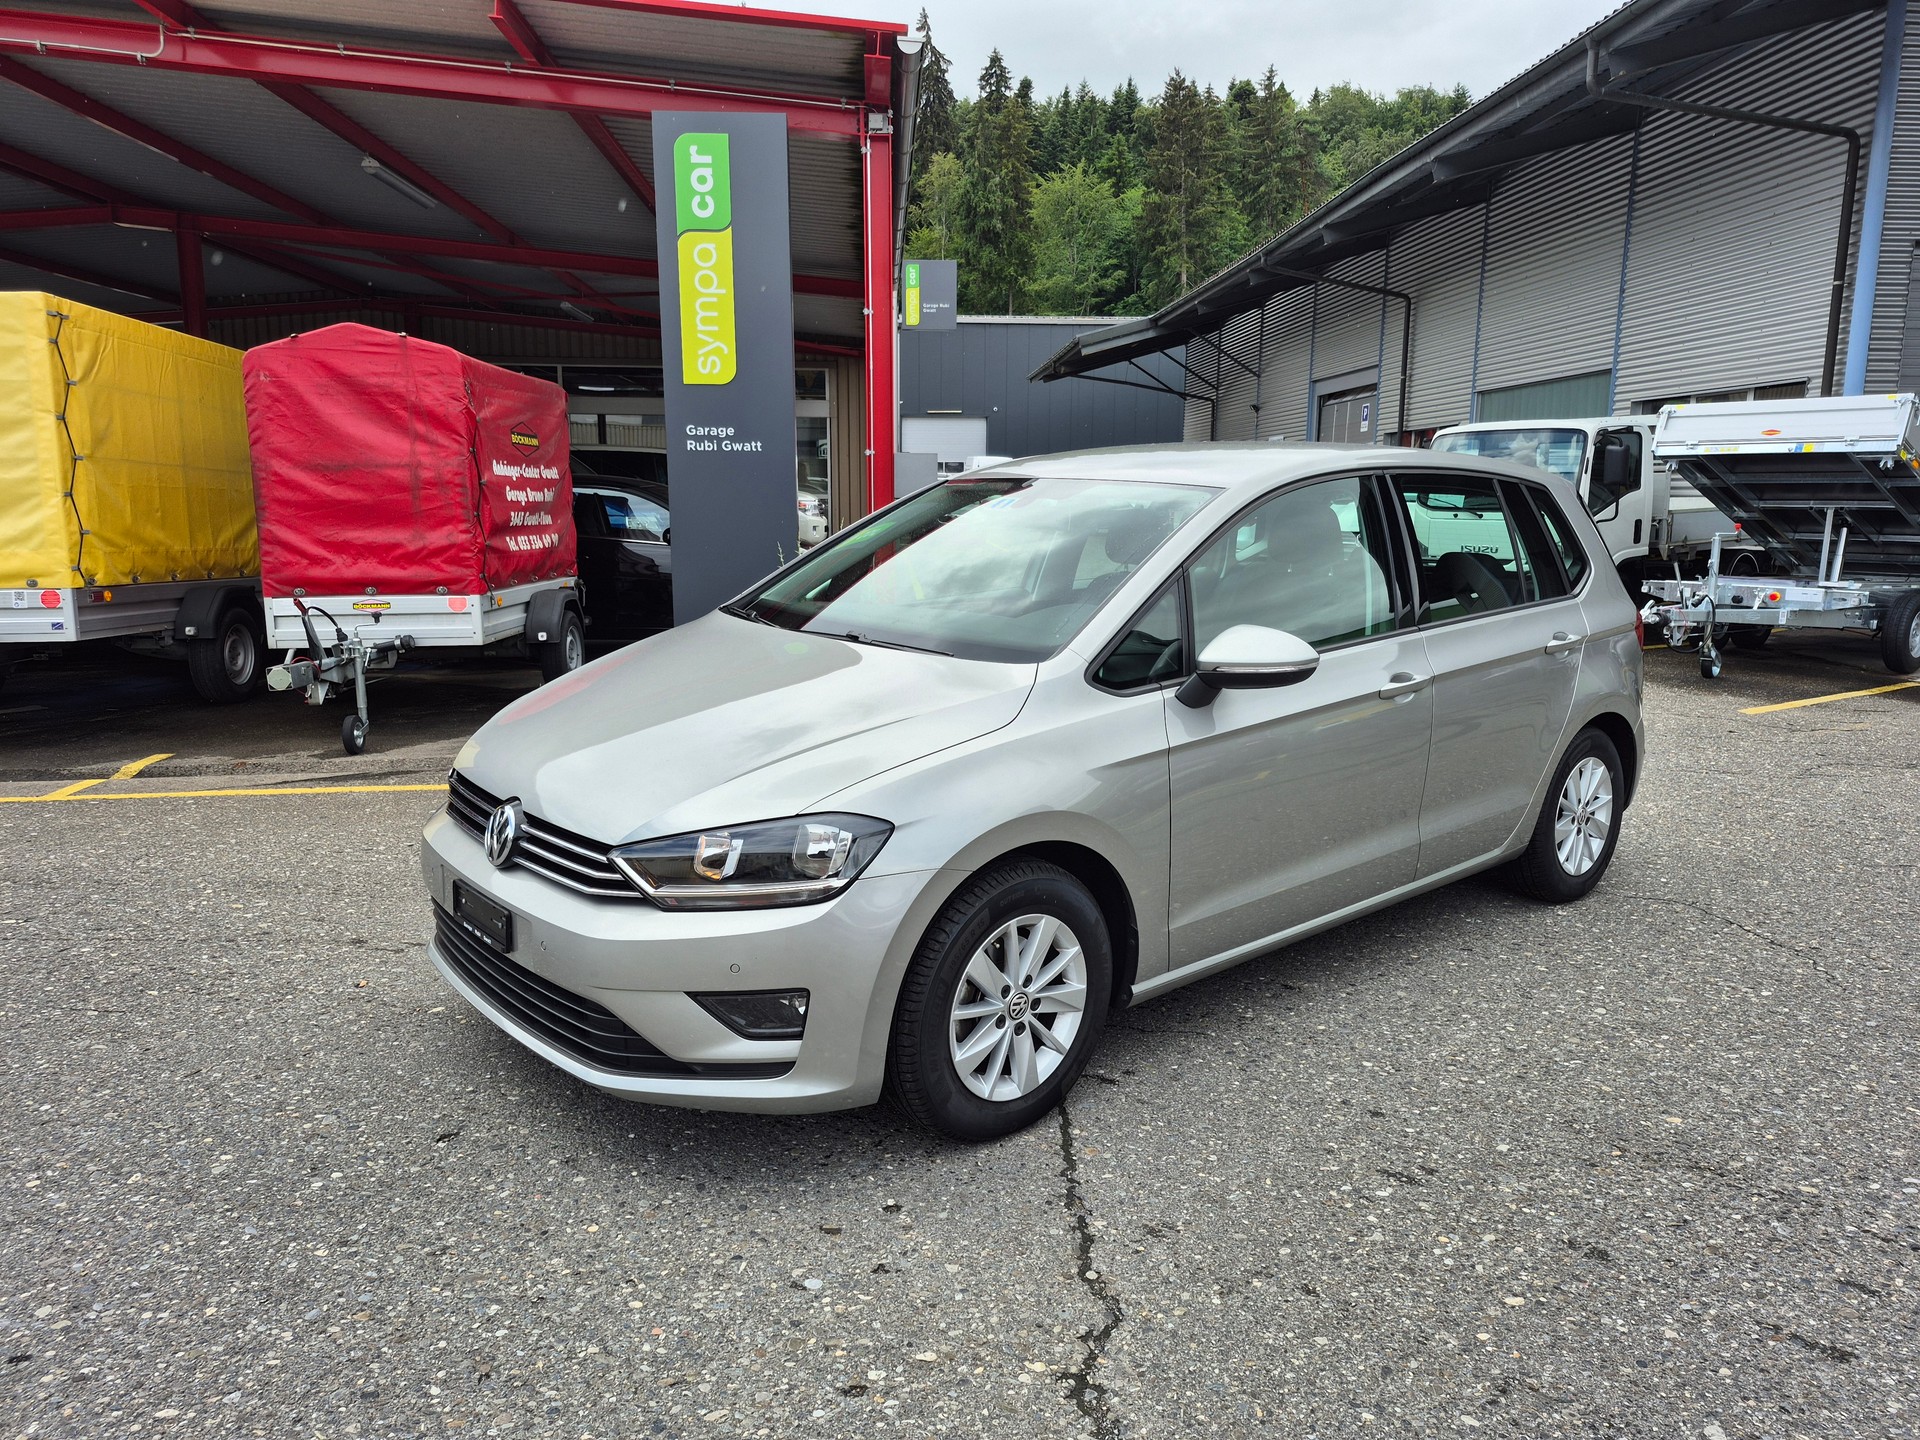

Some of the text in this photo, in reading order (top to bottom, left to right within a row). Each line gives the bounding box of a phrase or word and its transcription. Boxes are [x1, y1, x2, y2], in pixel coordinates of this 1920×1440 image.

[689, 145, 715, 218] car
[693, 243, 728, 374] sympa
[686, 424, 735, 438] Garage
[511, 433, 539, 446] BÖCKMANN
[687, 439, 762, 451] Rubi Gwatt
[506, 485, 527, 506] Garage
[527, 487, 543, 502] Bruno
[518, 535, 531, 551] 033
[1460, 545, 1499, 554] ISUZU
